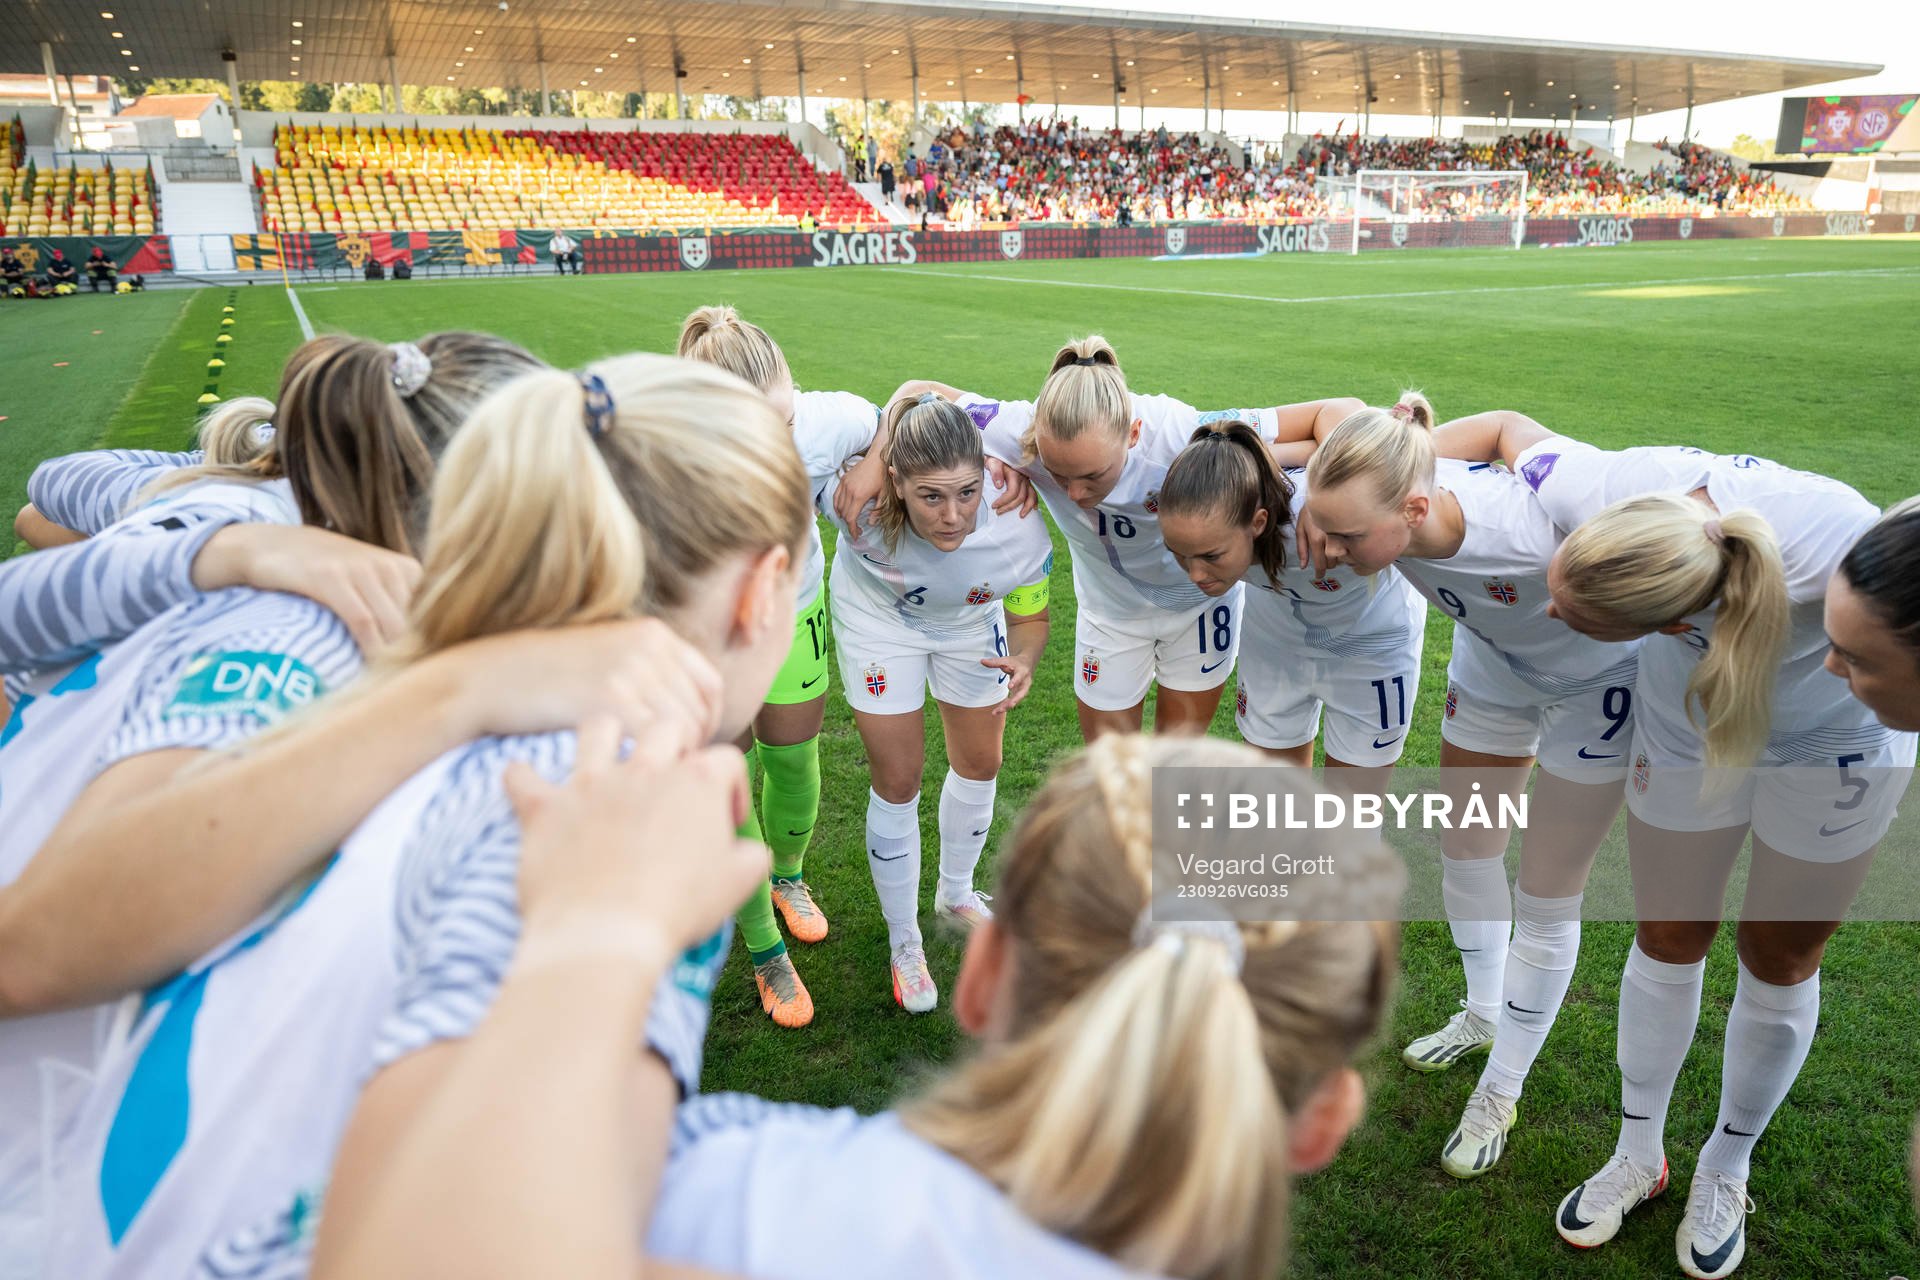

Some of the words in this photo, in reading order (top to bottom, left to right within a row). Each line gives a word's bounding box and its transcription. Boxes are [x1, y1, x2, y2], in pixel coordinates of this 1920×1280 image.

[1256, 224, 1329, 253] SAGRES
[1577, 218, 1634, 243] SAGRES
[812, 231, 917, 267] SAGRES
[1098, 508, 1137, 539] 18
[903, 586, 929, 606] 6
[1437, 587, 1467, 618] 9
[1198, 605, 1231, 654] 18
[212, 657, 316, 703] DNB
[1371, 675, 1406, 730] 11
[1600, 686, 1632, 741] 9
[1834, 752, 1870, 811] 5
